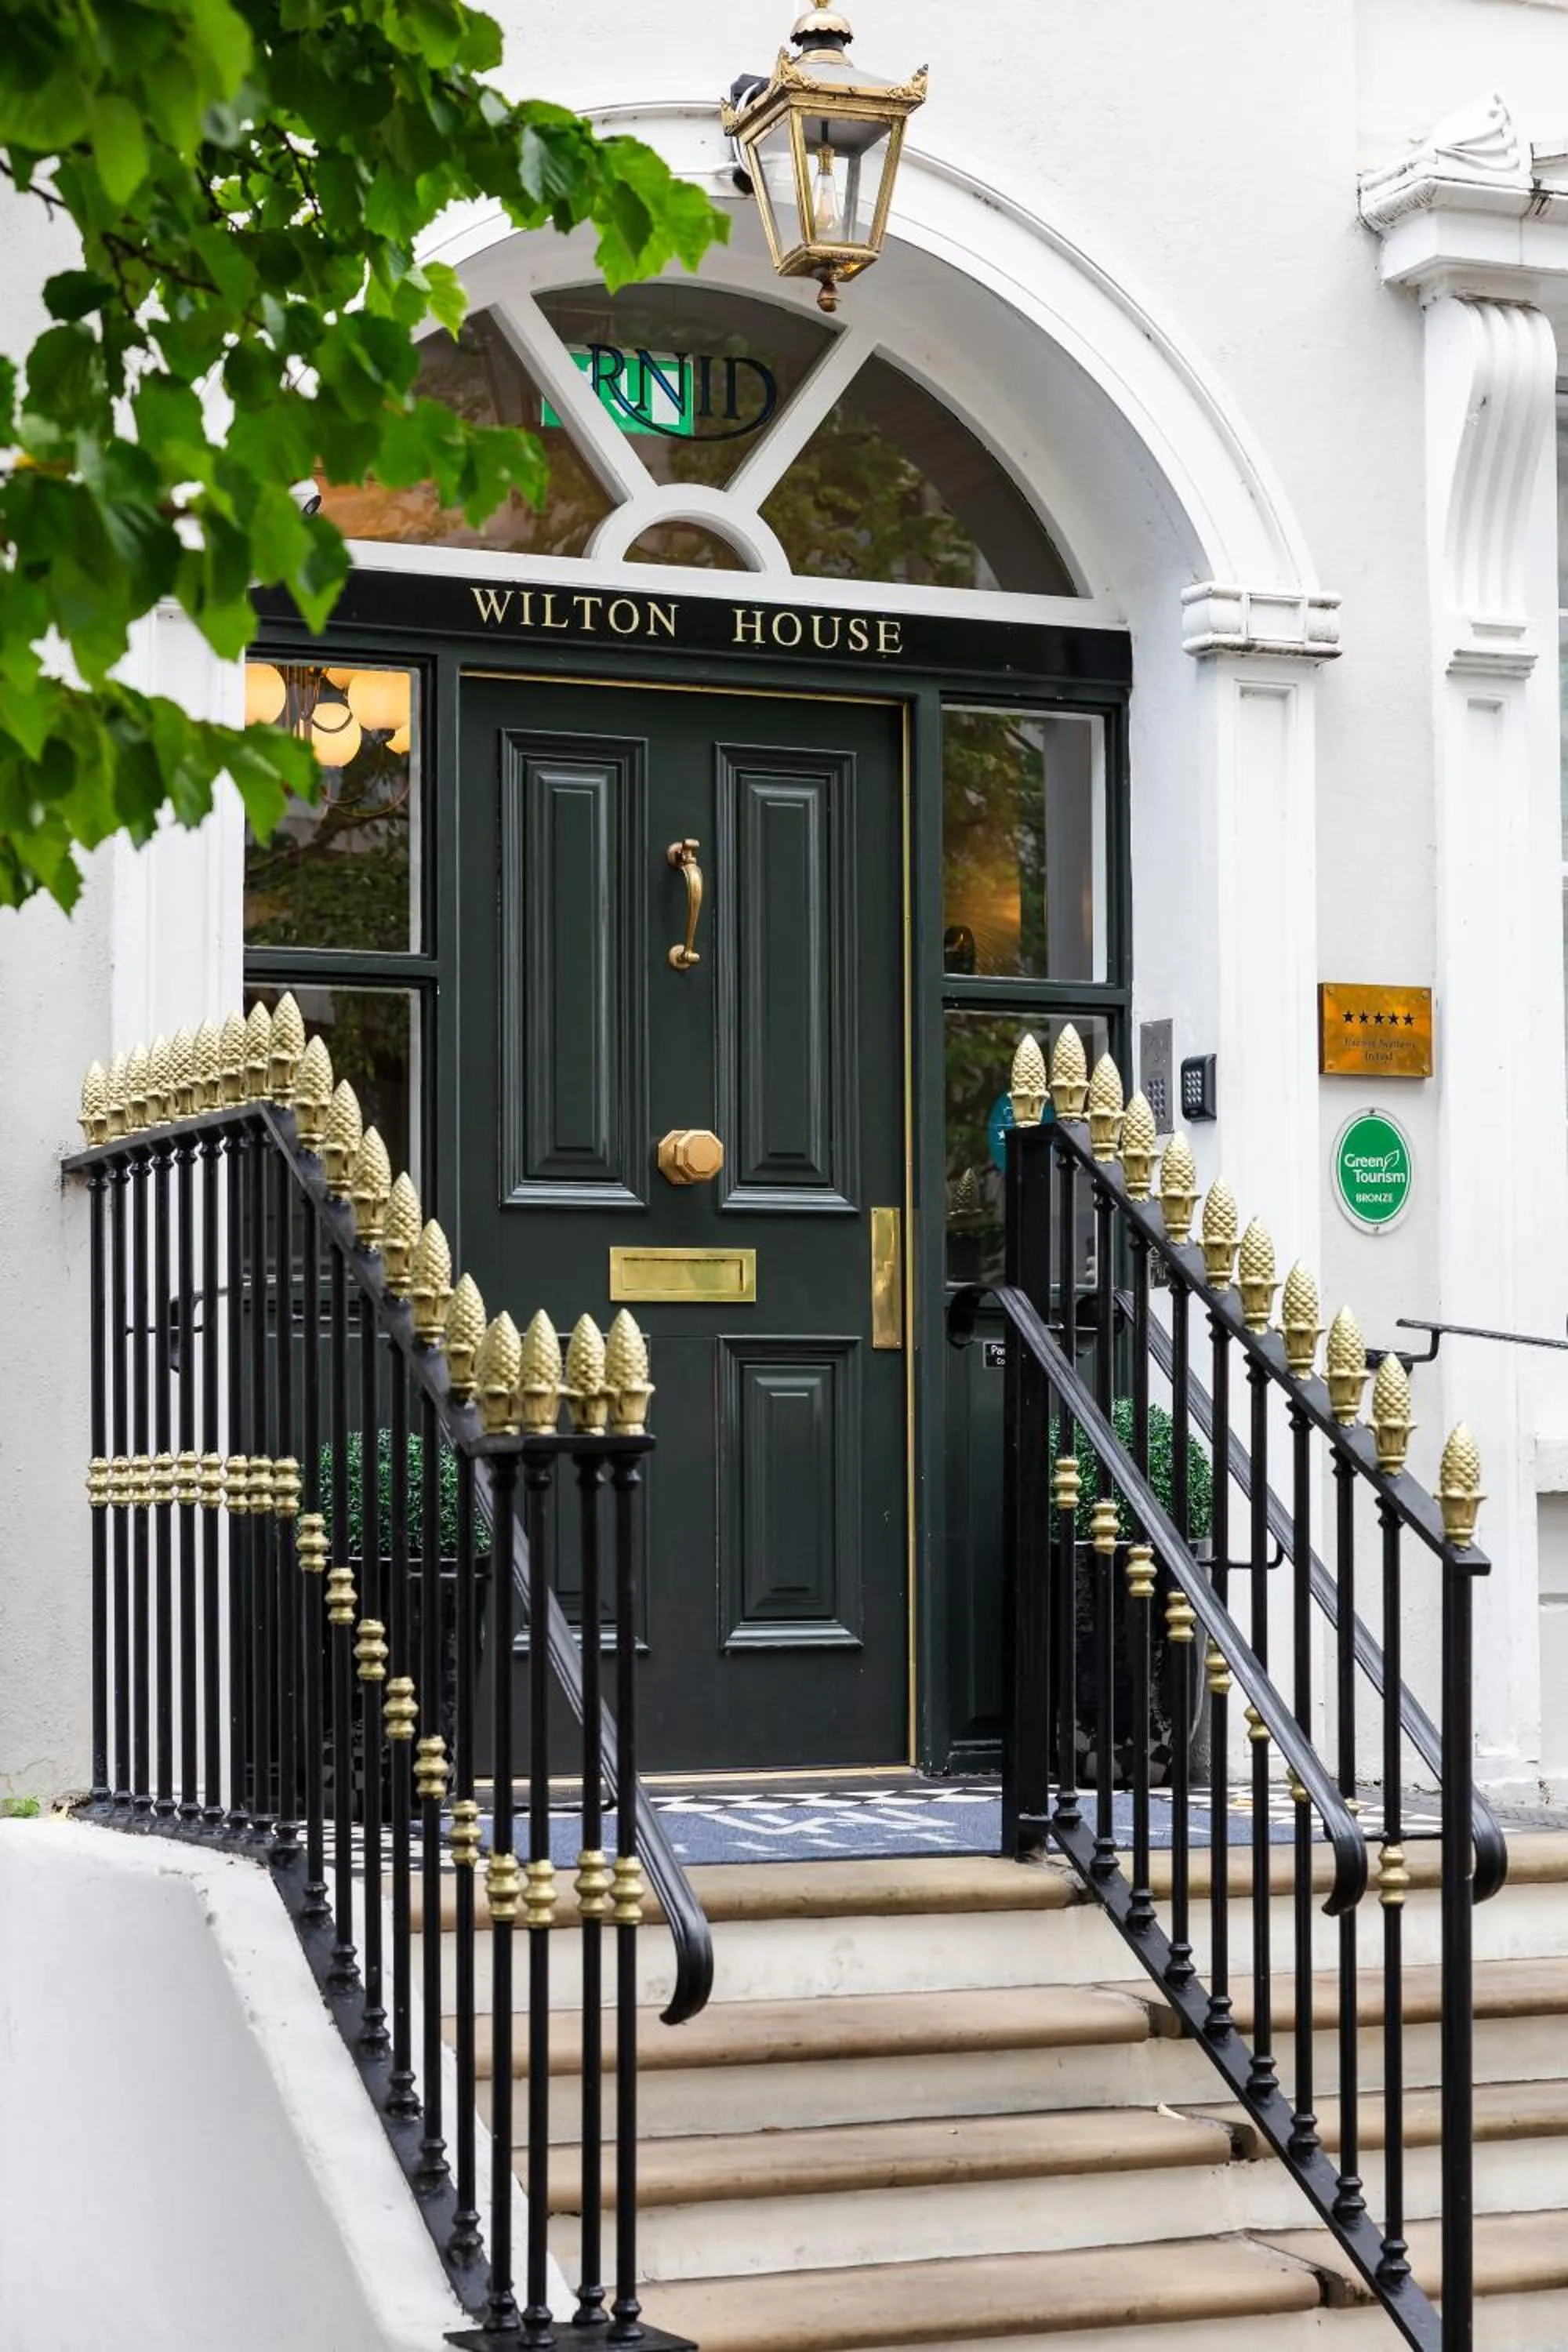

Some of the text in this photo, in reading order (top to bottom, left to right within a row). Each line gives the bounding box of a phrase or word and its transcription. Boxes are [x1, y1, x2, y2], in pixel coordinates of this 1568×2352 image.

[586, 343, 777, 441] RNID
[470, 587, 904, 654] WILTON HOUSE
[1345, 1153, 1384, 1167] Green
[1353, 1169, 1406, 1183] Tourism
[1356, 1192, 1393, 1203] BRONZE
